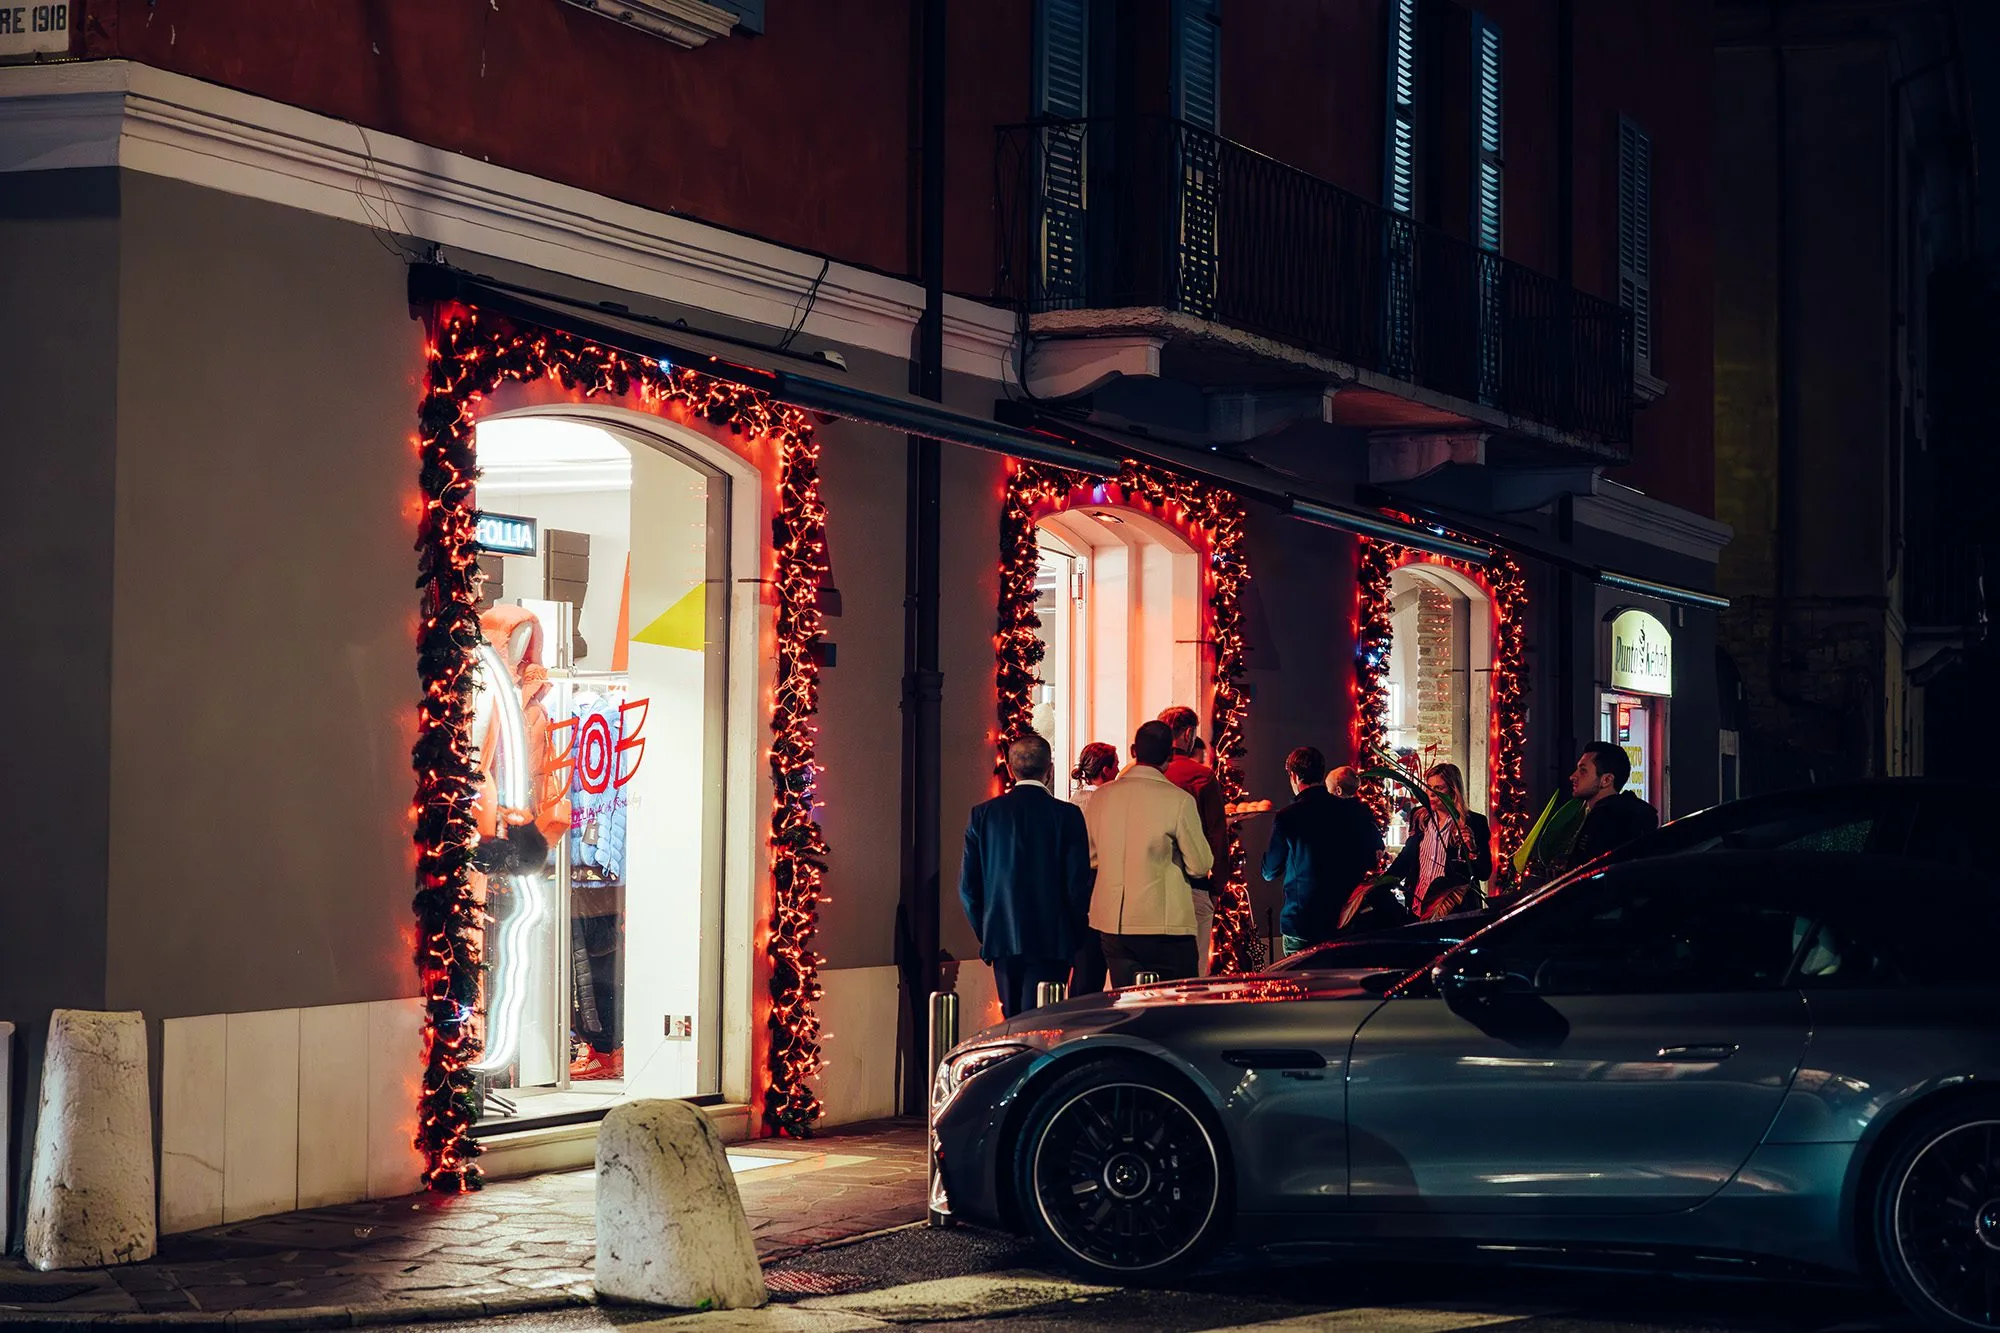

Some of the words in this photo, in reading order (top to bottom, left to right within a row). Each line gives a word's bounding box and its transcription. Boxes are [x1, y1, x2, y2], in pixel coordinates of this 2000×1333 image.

[33, 5, 67, 32] 1918
[476, 519, 533, 549] FOLLIA
[1615, 635, 1639, 674] Punto
[542, 698, 649, 812] BOB
